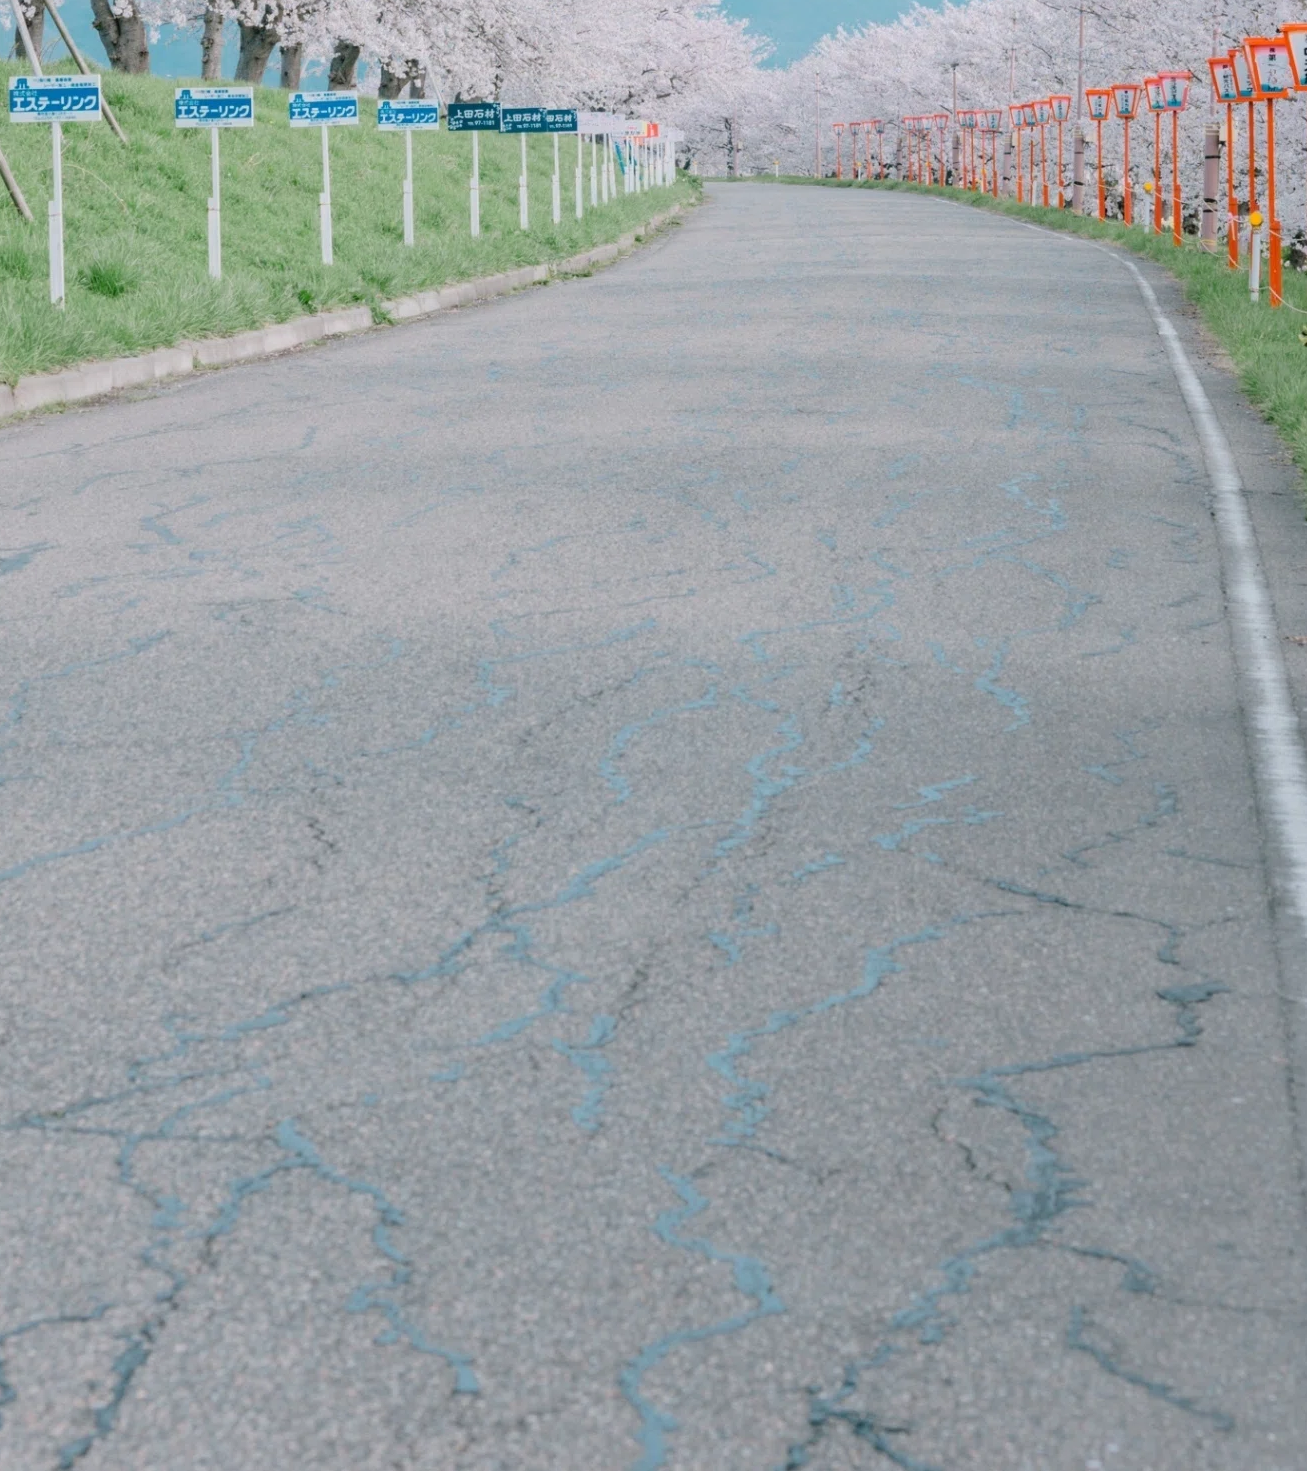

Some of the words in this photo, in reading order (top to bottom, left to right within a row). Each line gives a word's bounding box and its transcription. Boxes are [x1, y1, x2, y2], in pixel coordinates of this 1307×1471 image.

[12, 95, 97, 111] エステーリンク
[177, 105, 250, 118] エステーリンク
[292, 105, 356, 119] エステーリンク
[454, 109, 495, 119] 上田石材
[379, 113, 437, 124] エステーリンク
[503, 113, 541, 122] 上田石材
[546, 113, 572, 122] 田石材
